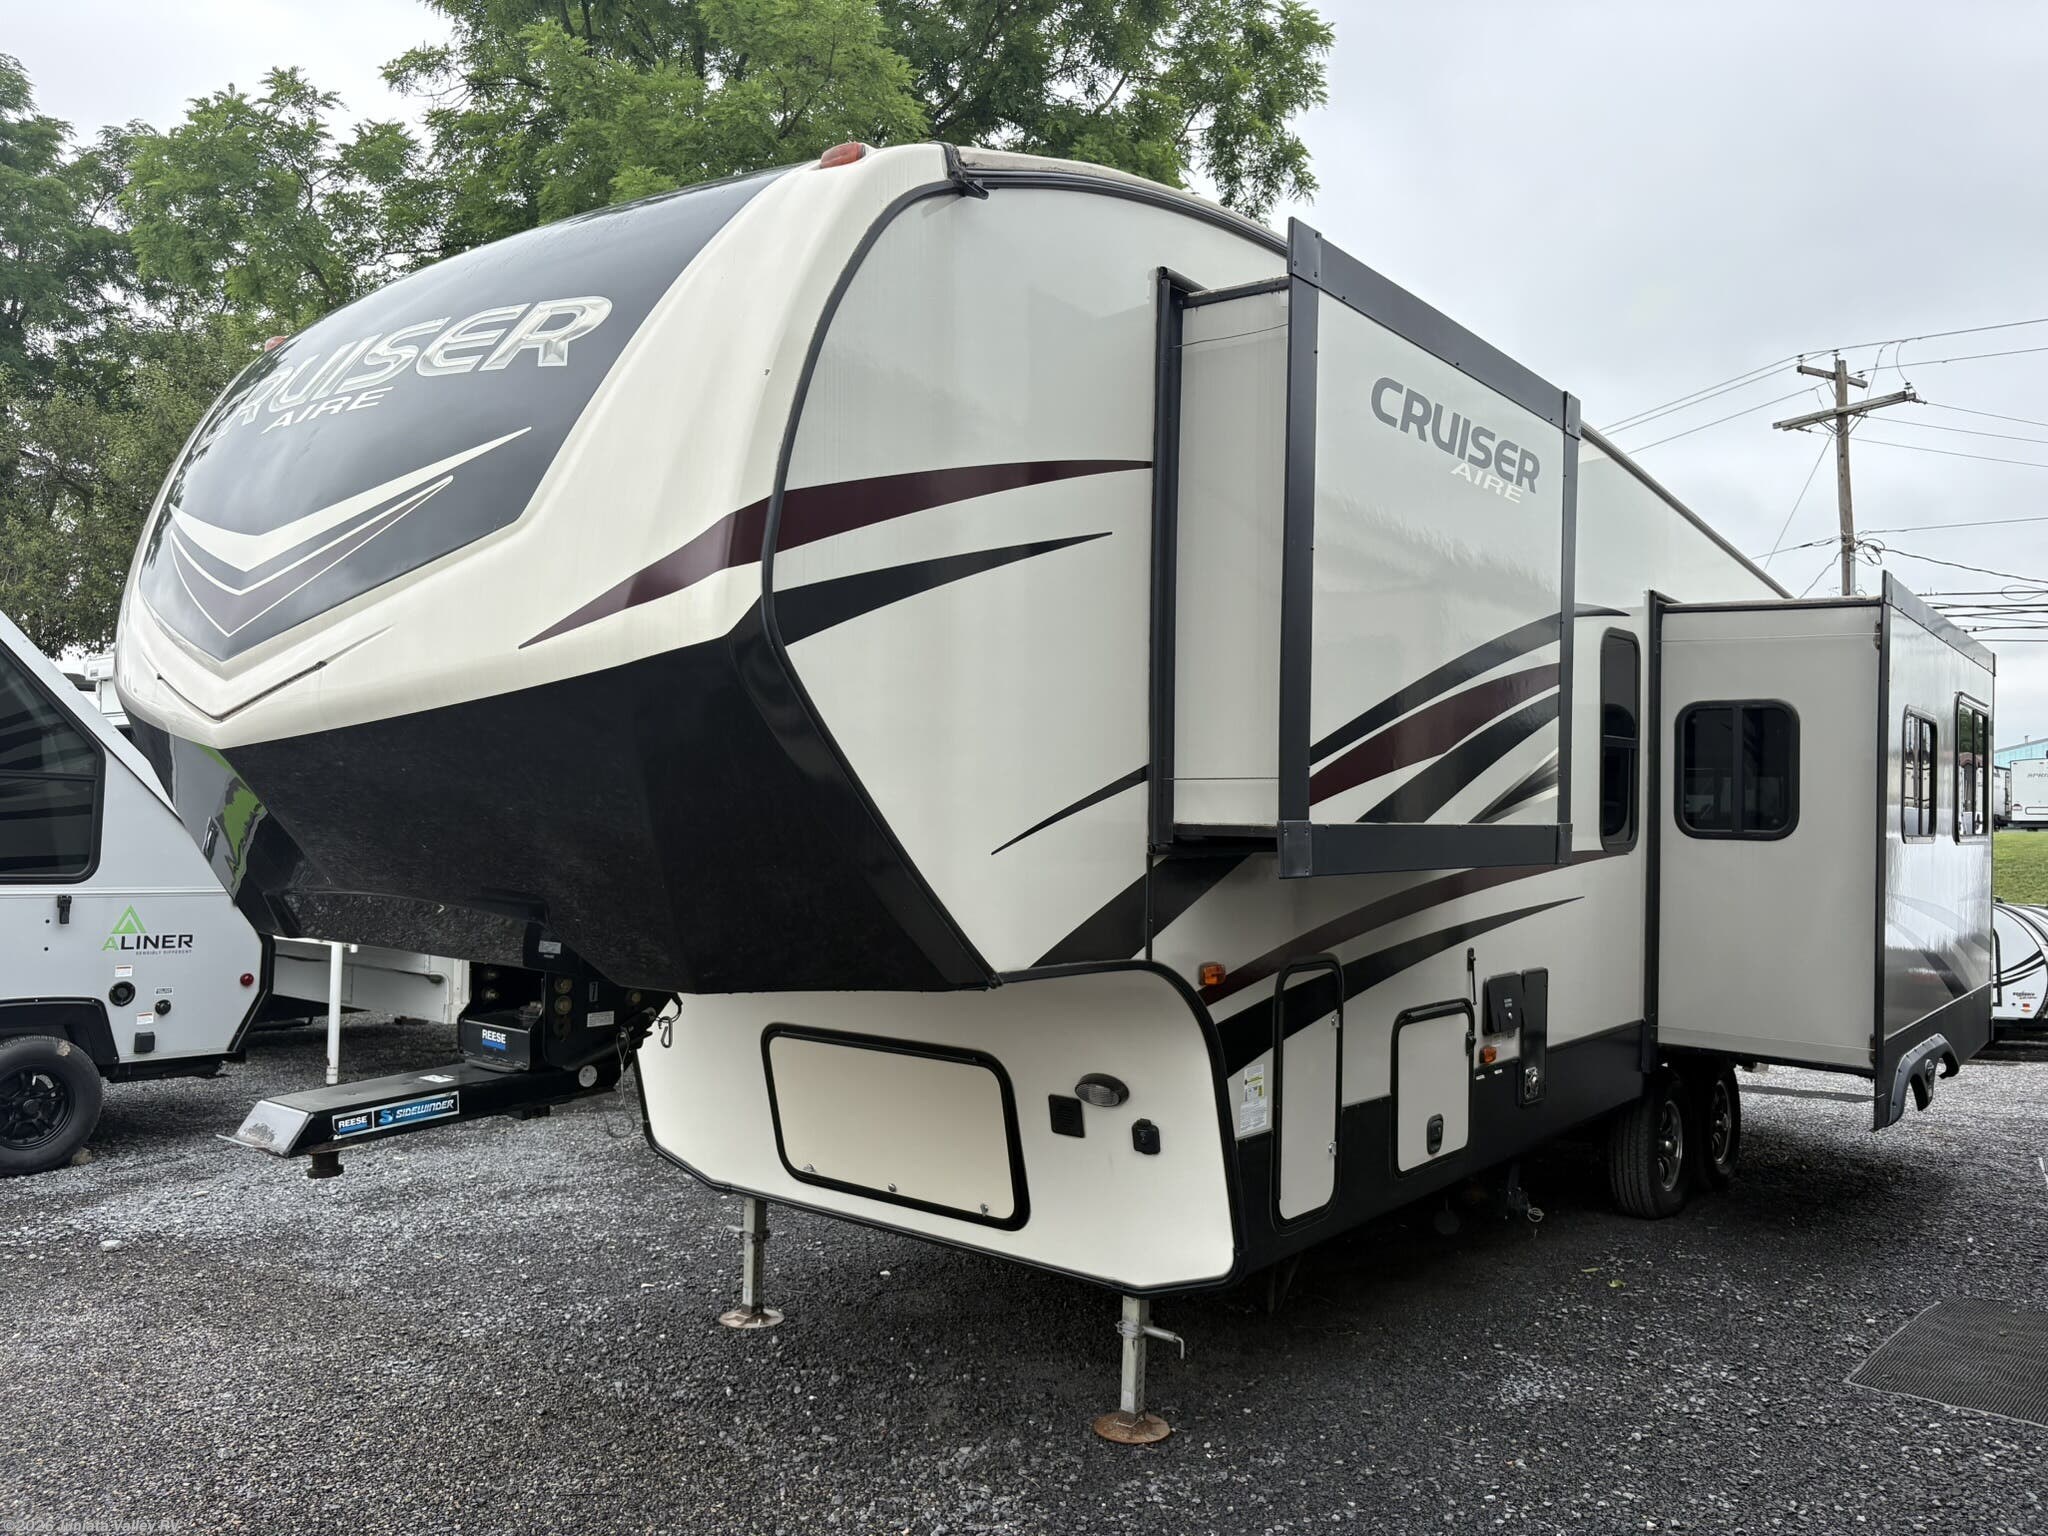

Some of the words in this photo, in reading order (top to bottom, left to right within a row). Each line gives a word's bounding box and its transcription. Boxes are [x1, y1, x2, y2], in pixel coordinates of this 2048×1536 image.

[260, 386, 393, 434] AIRE
[1371, 376, 1541, 494] CRUISER
[1450, 462, 1525, 503] AIRE
[102, 934, 193, 951] ALINER
[482, 1029, 507, 1044] REESE
[338, 1115, 367, 1128] REESE
[396, 1099, 454, 1119] SIDEWINDER
